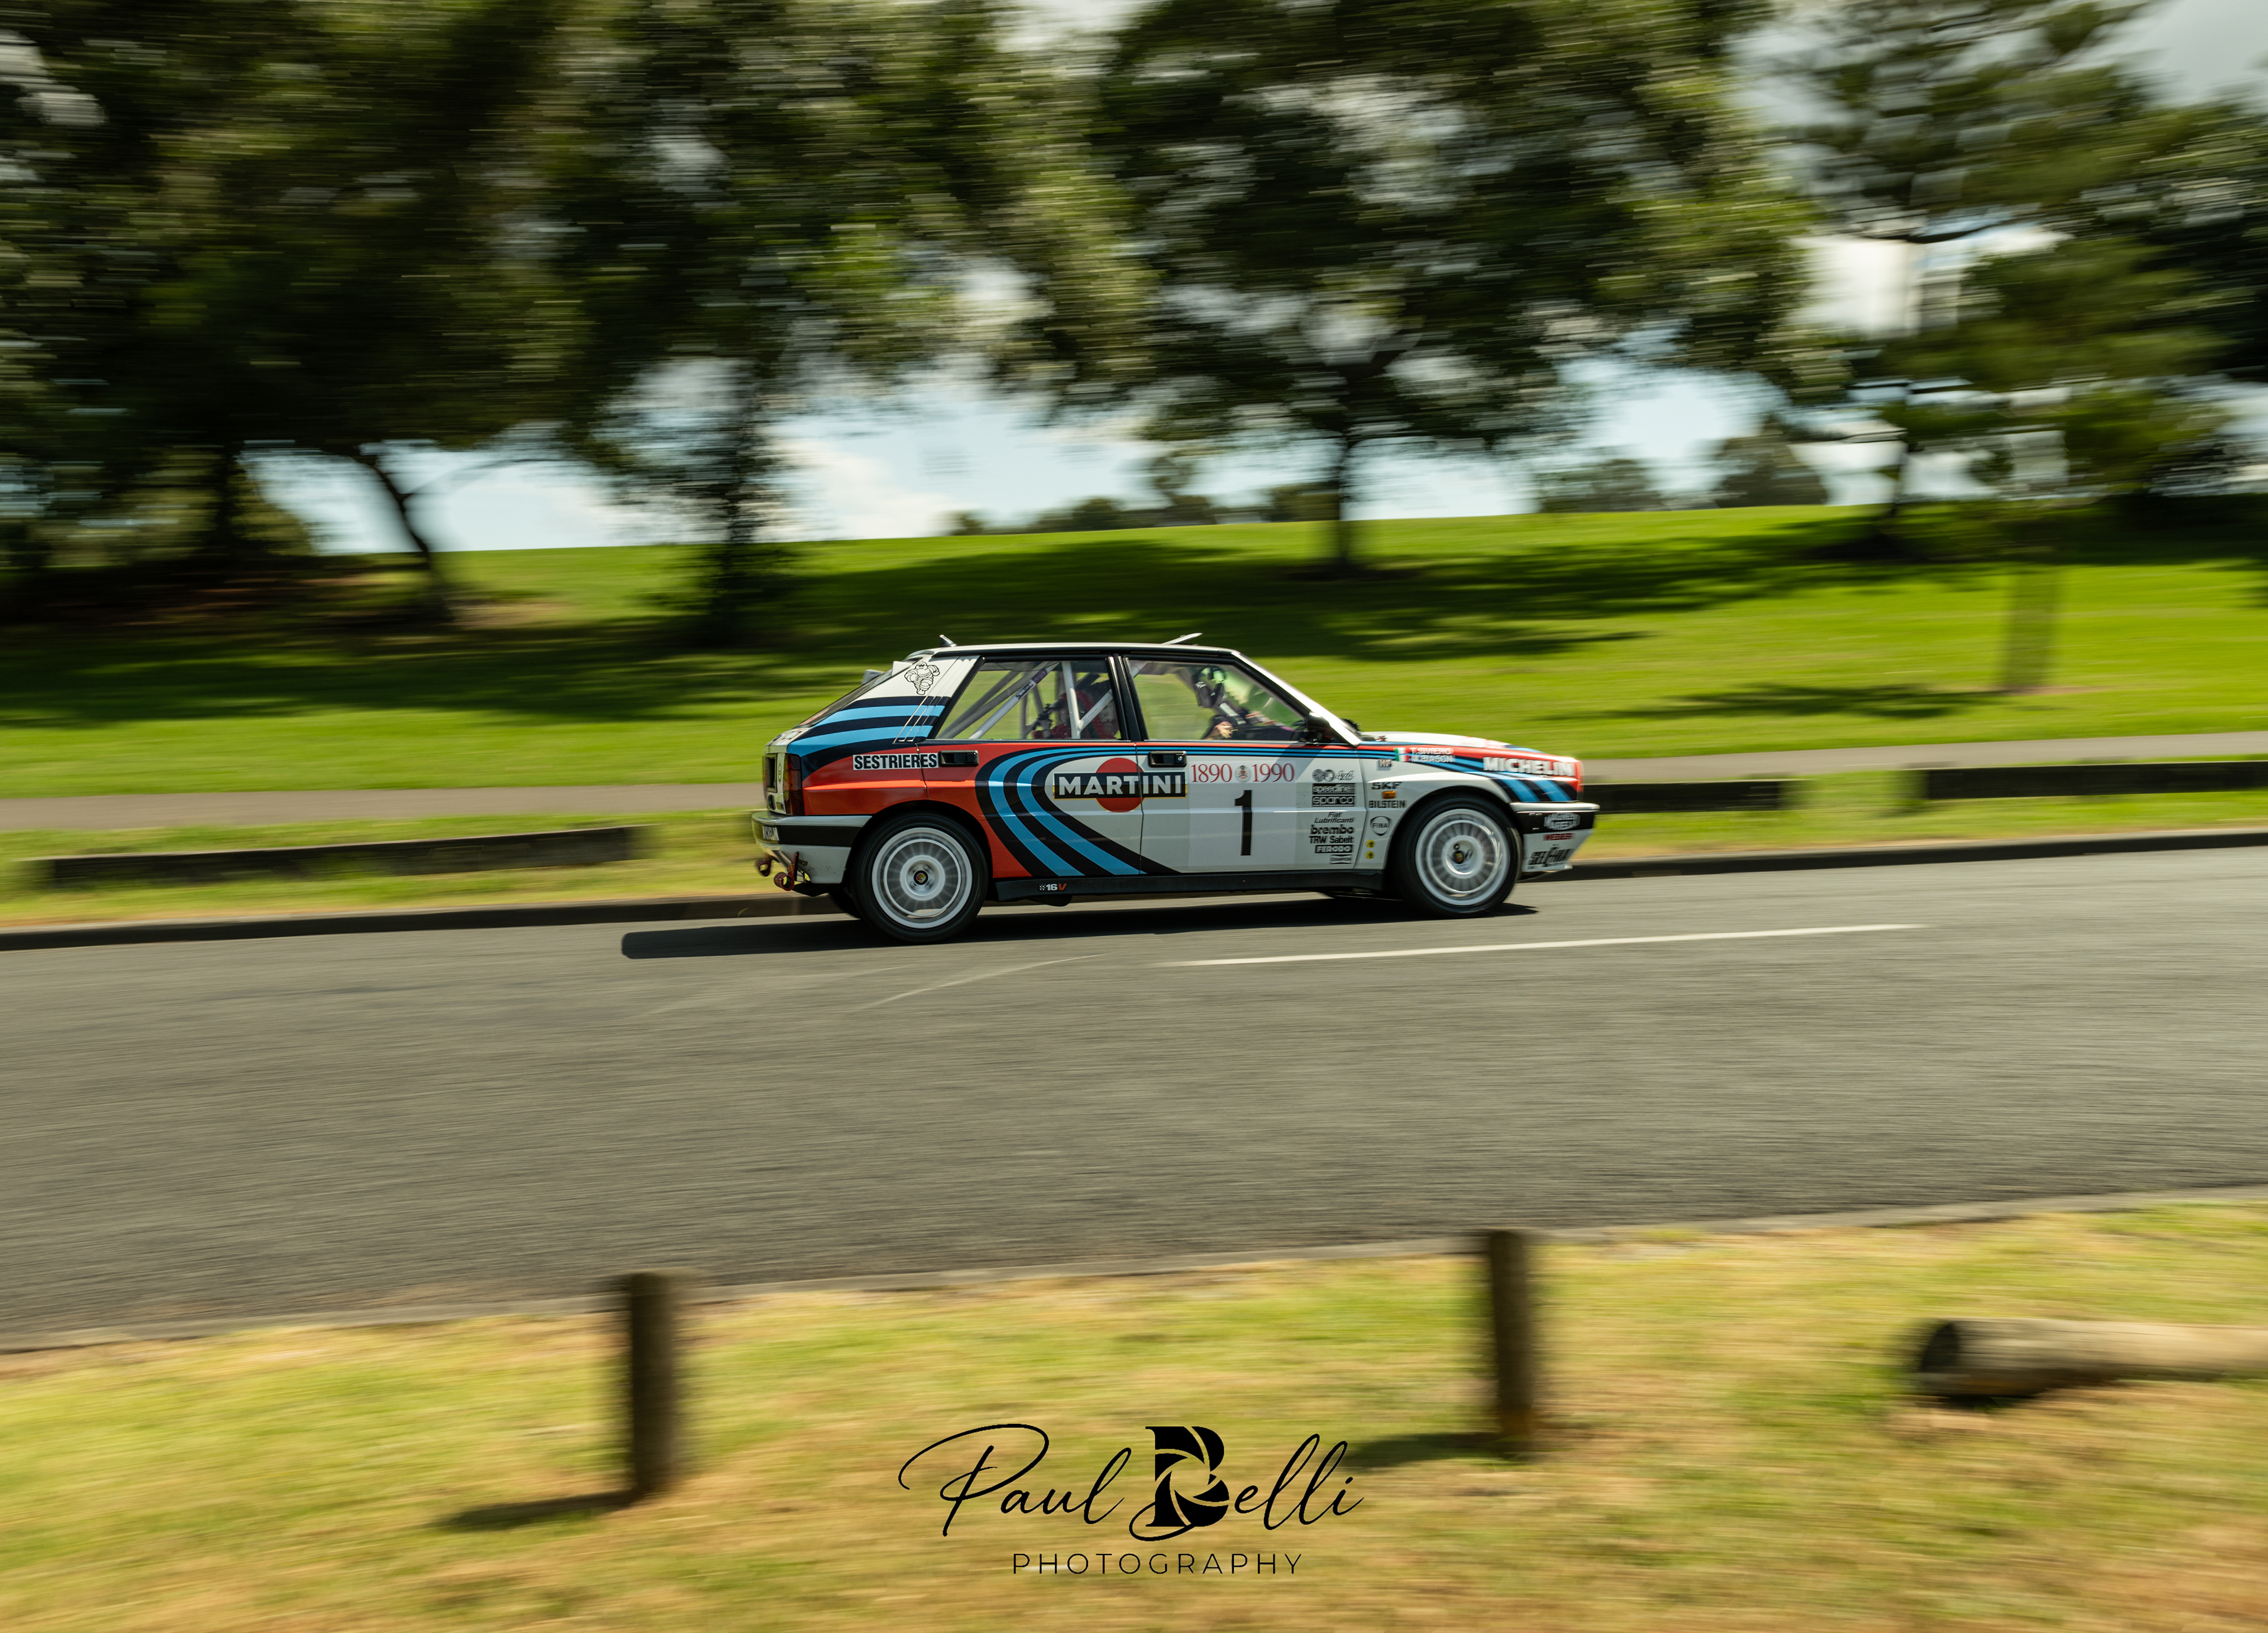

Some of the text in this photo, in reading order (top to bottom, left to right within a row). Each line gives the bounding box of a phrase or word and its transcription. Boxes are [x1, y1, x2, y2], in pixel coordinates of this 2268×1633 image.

[854, 754, 937, 770] SESTRIERES
[1482, 757, 1576, 777] MICHELIN
[1190, 763, 1295, 783] 1890 1990
[1335, 770, 1355, 781] 4x4
[1058, 775, 1182, 796] MARTINI
[1312, 796, 1354, 807] sparco
[1234, 790, 1253, 856] 1
[1310, 824, 1354, 835] brembo
[1329, 835, 1354, 843] Sabelt
